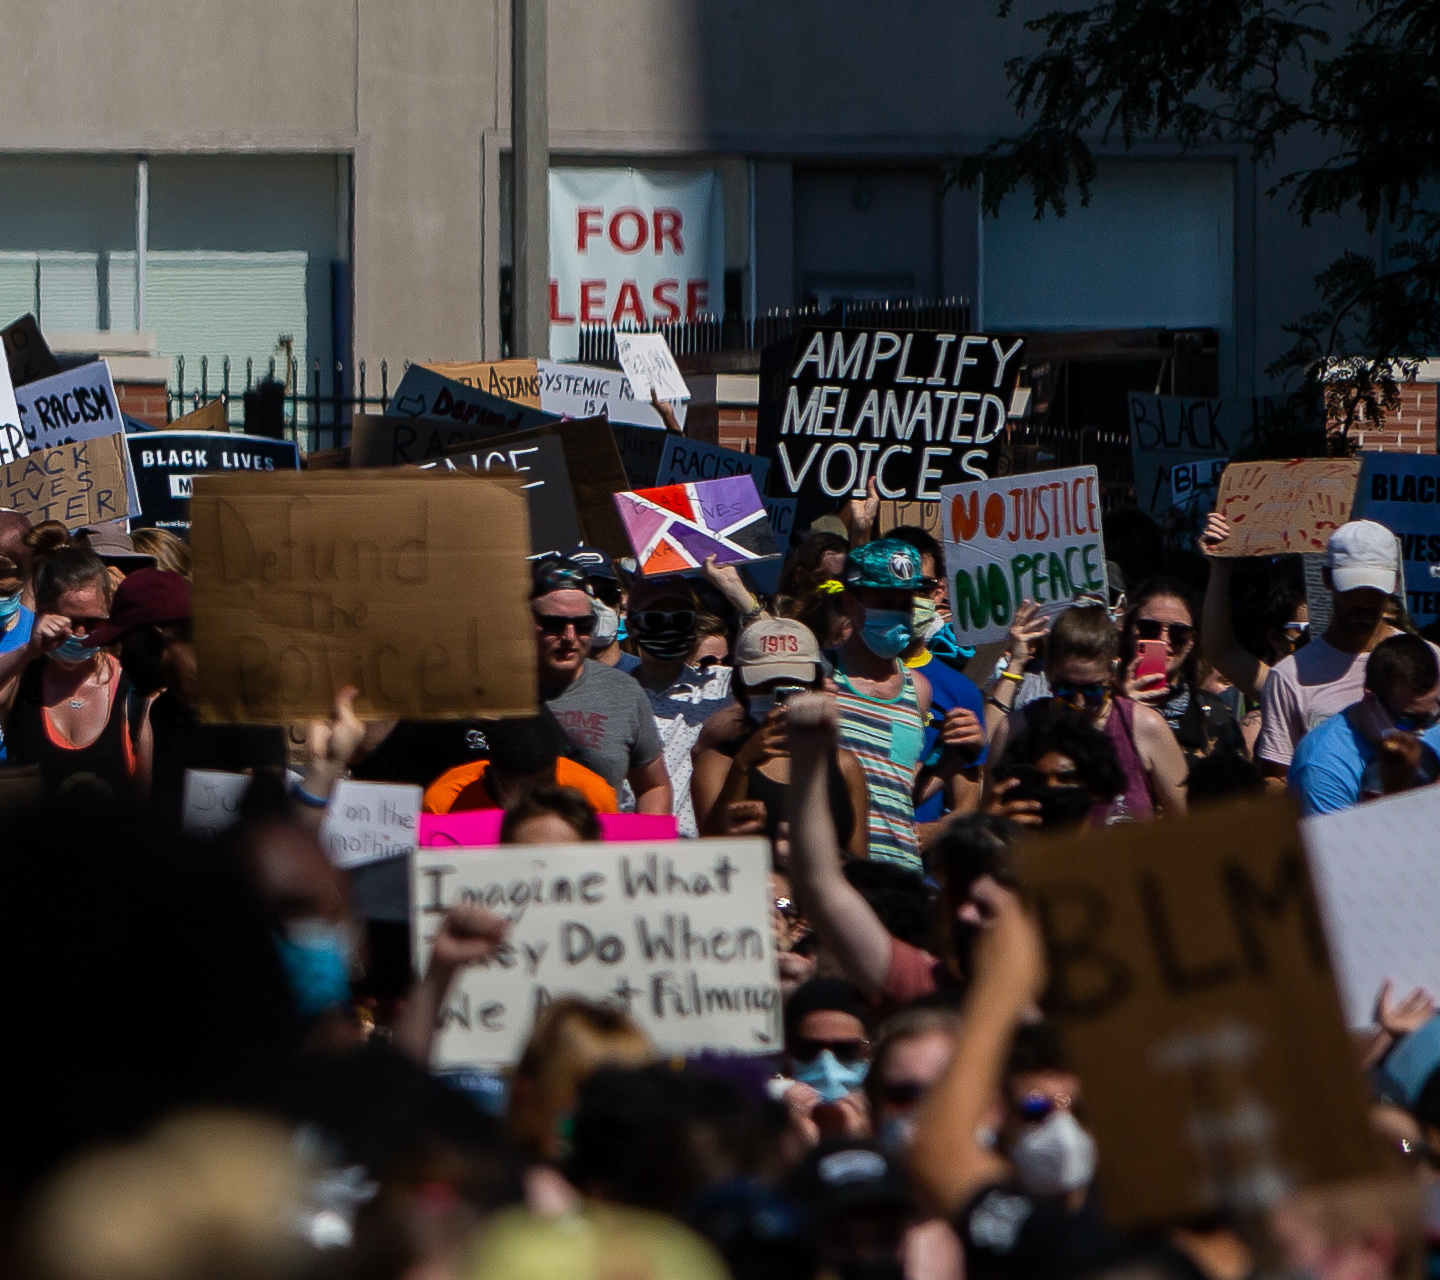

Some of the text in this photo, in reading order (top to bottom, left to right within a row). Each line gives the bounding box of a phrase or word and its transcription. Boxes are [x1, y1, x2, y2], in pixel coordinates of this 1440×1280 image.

[576, 205, 686, 257] FOR
[547, 277, 711, 326] LEASE
[488, 365, 541, 400] ASIANS
[537, 366, 611, 398] SYSTEMIC
[791, 330, 1024, 388] AMPLIFY
[35, 384, 115, 433] RACISM
[779, 383, 1006, 444] MELANATED
[1130, 396, 1230, 451] BLACK
[141, 449, 276, 472] BLACK LIVES
[669, 444, 753, 481] RACISM
[777, 440, 989, 499] VOICES
[8, 470, 96, 511] IVES
[950, 488, 1006, 544] NO
[1006, 475, 1101, 544] JUSTICE
[1370, 472, 1440, 504] BLAC
[953, 542, 1105, 632] NO PEACE
[759, 633, 800, 654] 1913
[418, 852, 741, 924] Imagine What
[559, 918, 765, 966] Do When
[1036, 853, 1328, 1015] BLM
[648, 974, 778, 1021] Filming
